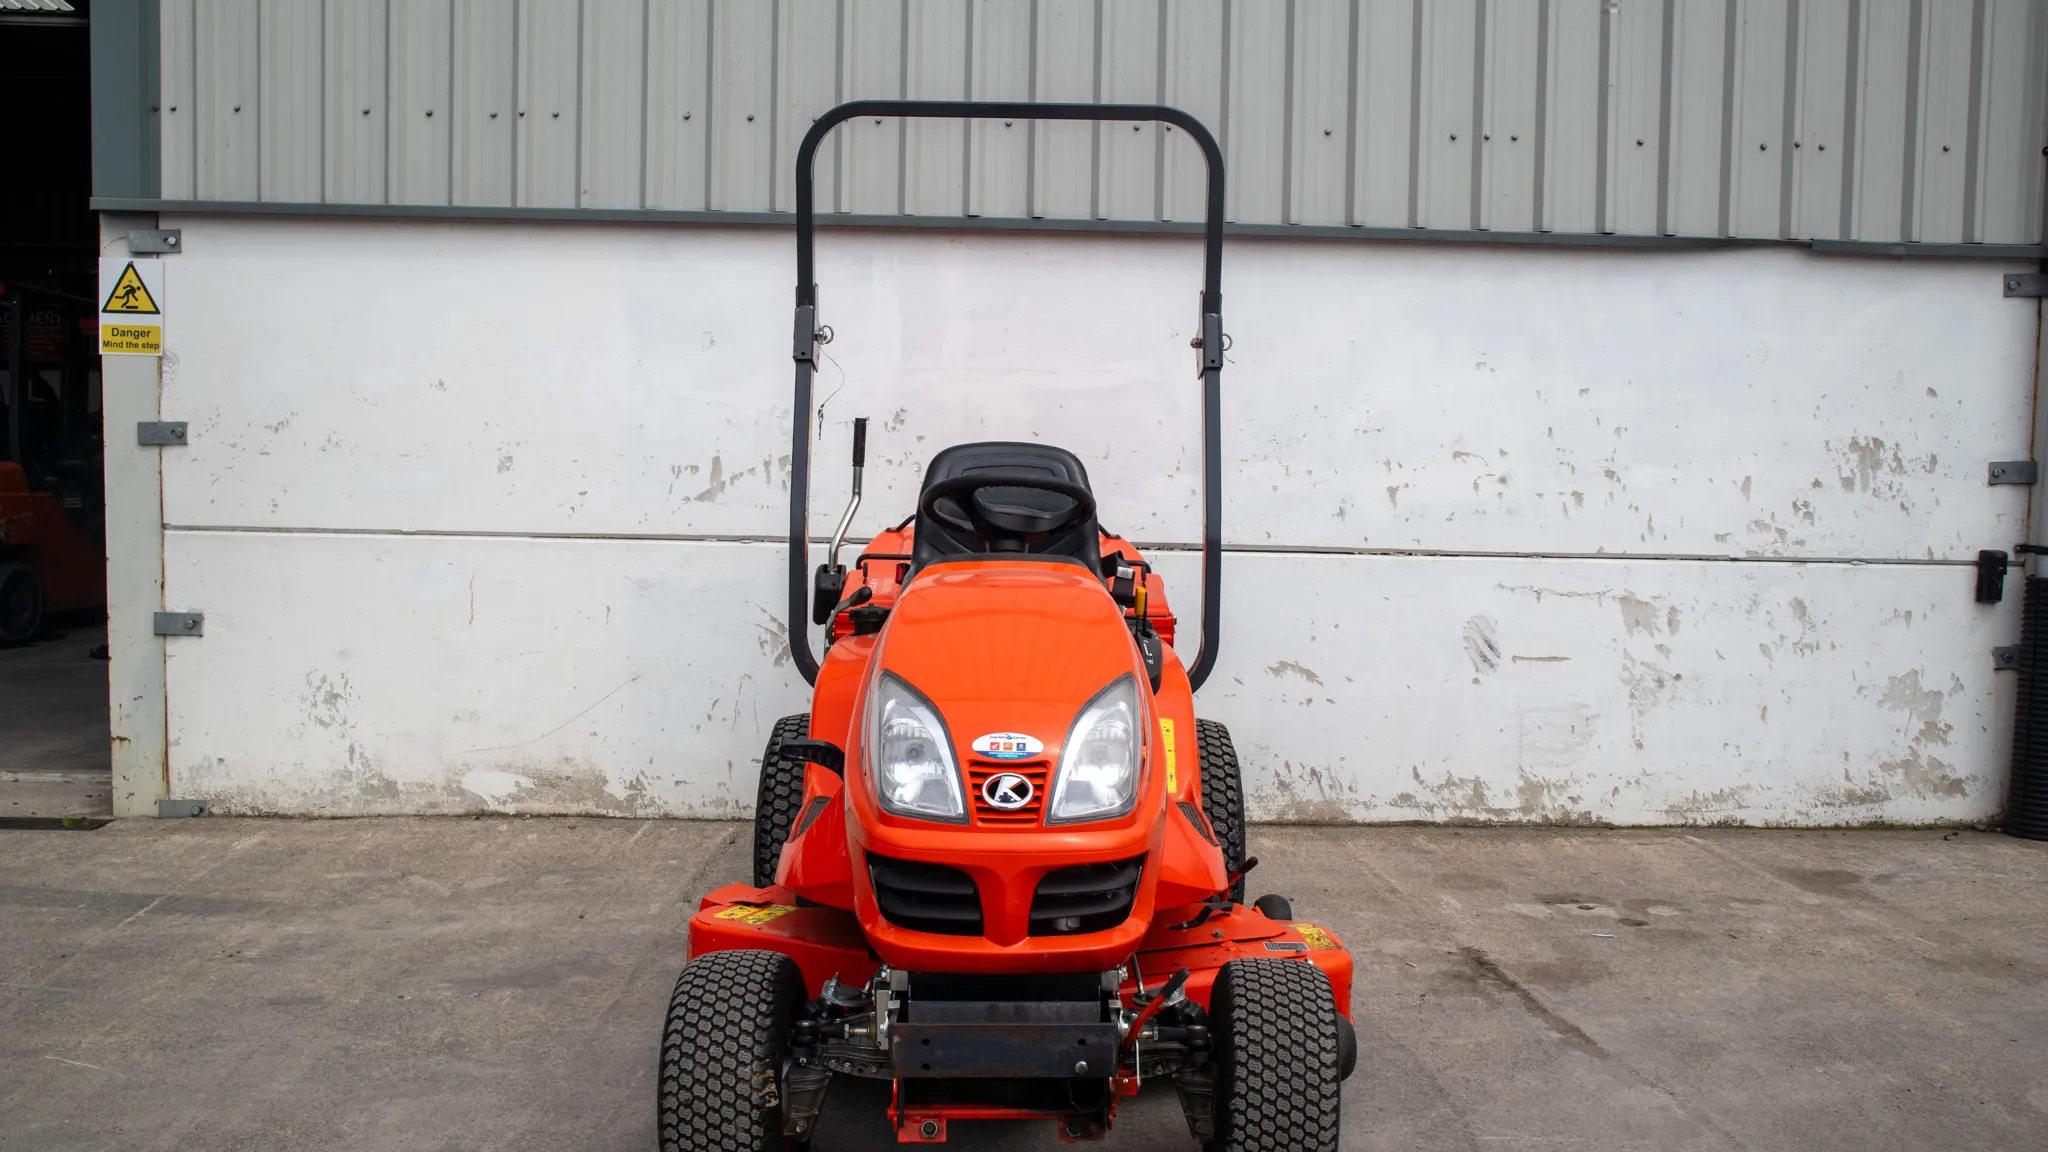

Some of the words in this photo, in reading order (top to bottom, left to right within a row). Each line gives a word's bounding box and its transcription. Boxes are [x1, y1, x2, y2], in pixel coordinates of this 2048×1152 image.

[111, 327, 151, 340] Danger
[102, 340, 124, 348] Mind
[125, 341, 139, 349] the
[141, 342, 160, 350] step
